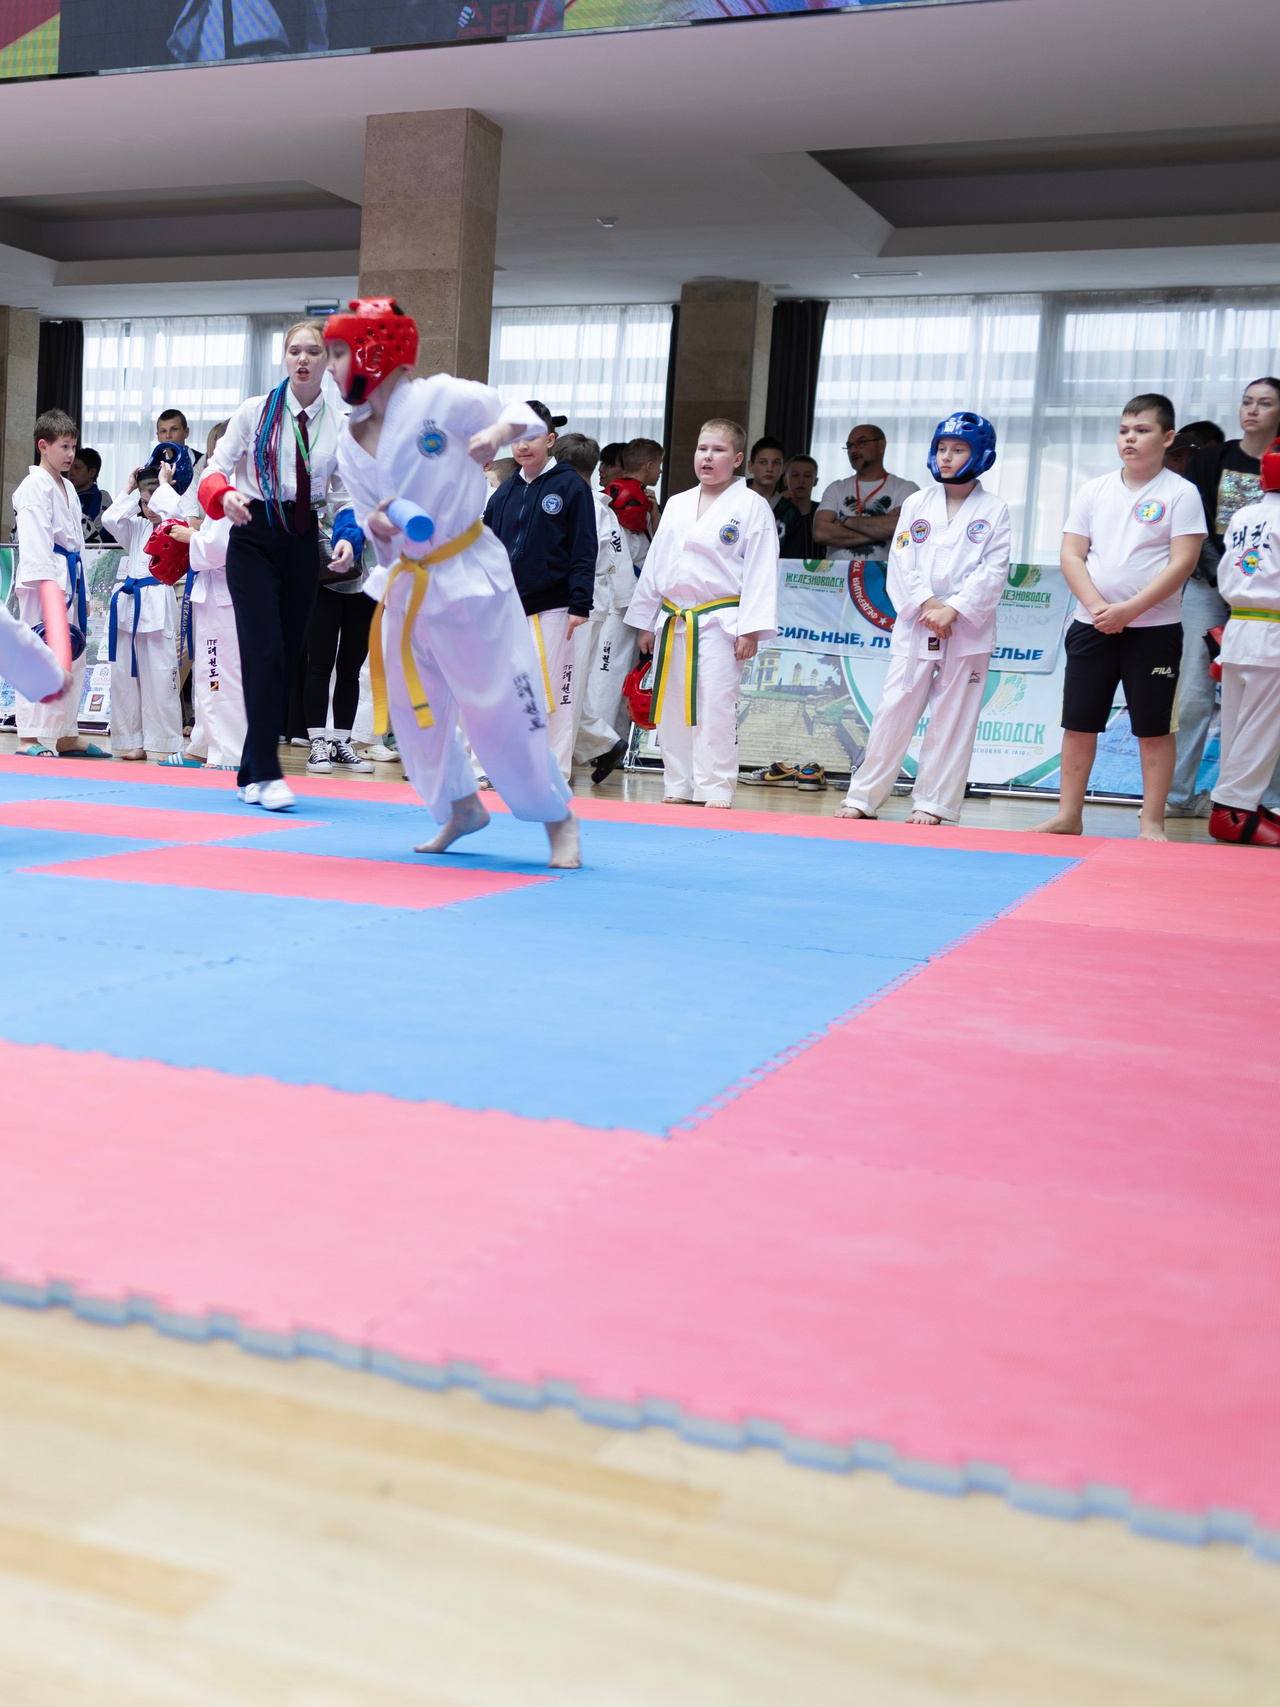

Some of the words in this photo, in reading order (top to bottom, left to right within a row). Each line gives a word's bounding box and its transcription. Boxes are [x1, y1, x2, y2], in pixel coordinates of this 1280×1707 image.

[785, 572, 845, 588] ЖЕЛЕЗНОВОДСК
[852, 577, 878, 619] ФЕДЕРАЦИЯ
[1000, 589, 1052, 603] ЛЕЗНОВОДСК
[776, 626, 864, 647] СИЛЬНЫЕ,
[990, 647, 1044, 661] ЕЛЫЕ
[1151, 666, 1172, 675] FILA
